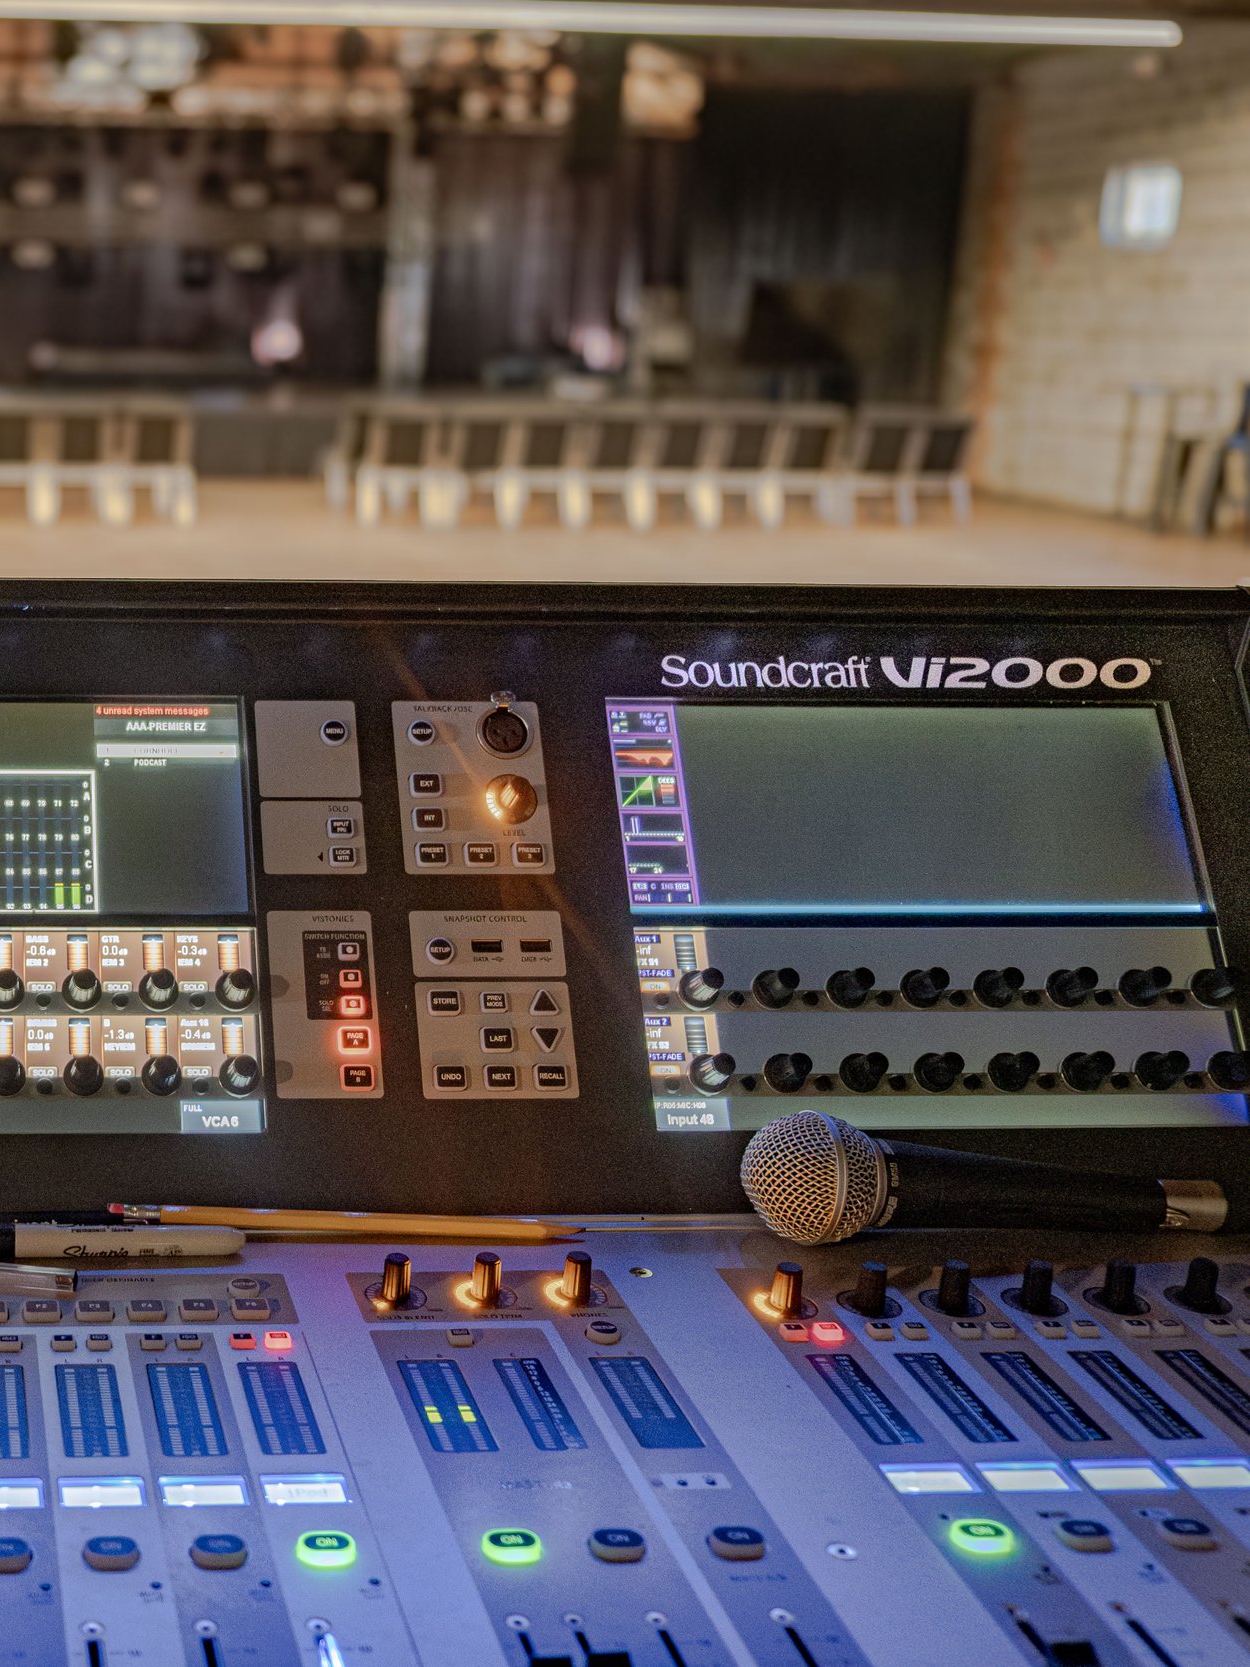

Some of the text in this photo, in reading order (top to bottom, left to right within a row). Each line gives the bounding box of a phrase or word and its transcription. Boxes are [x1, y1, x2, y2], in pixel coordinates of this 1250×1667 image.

[661, 655, 1151, 689] Soundcraft Vi2000
[103, 706, 132, 715] unread
[133, 706, 163, 717] system
[164, 707, 209, 717] messages
[193, 722, 206, 731] EZ
[327, 805, 349, 813] SOLO
[311, 915, 354, 923] VISTONICS
[443, 915, 527, 923] SNAPSHOT CONTROL
[634, 935, 651, 943] Aux
[32, 1069, 54, 1077] SOLO
[183, 1104, 203, 1112] FULL
[667, 1114, 698, 1127] Input
